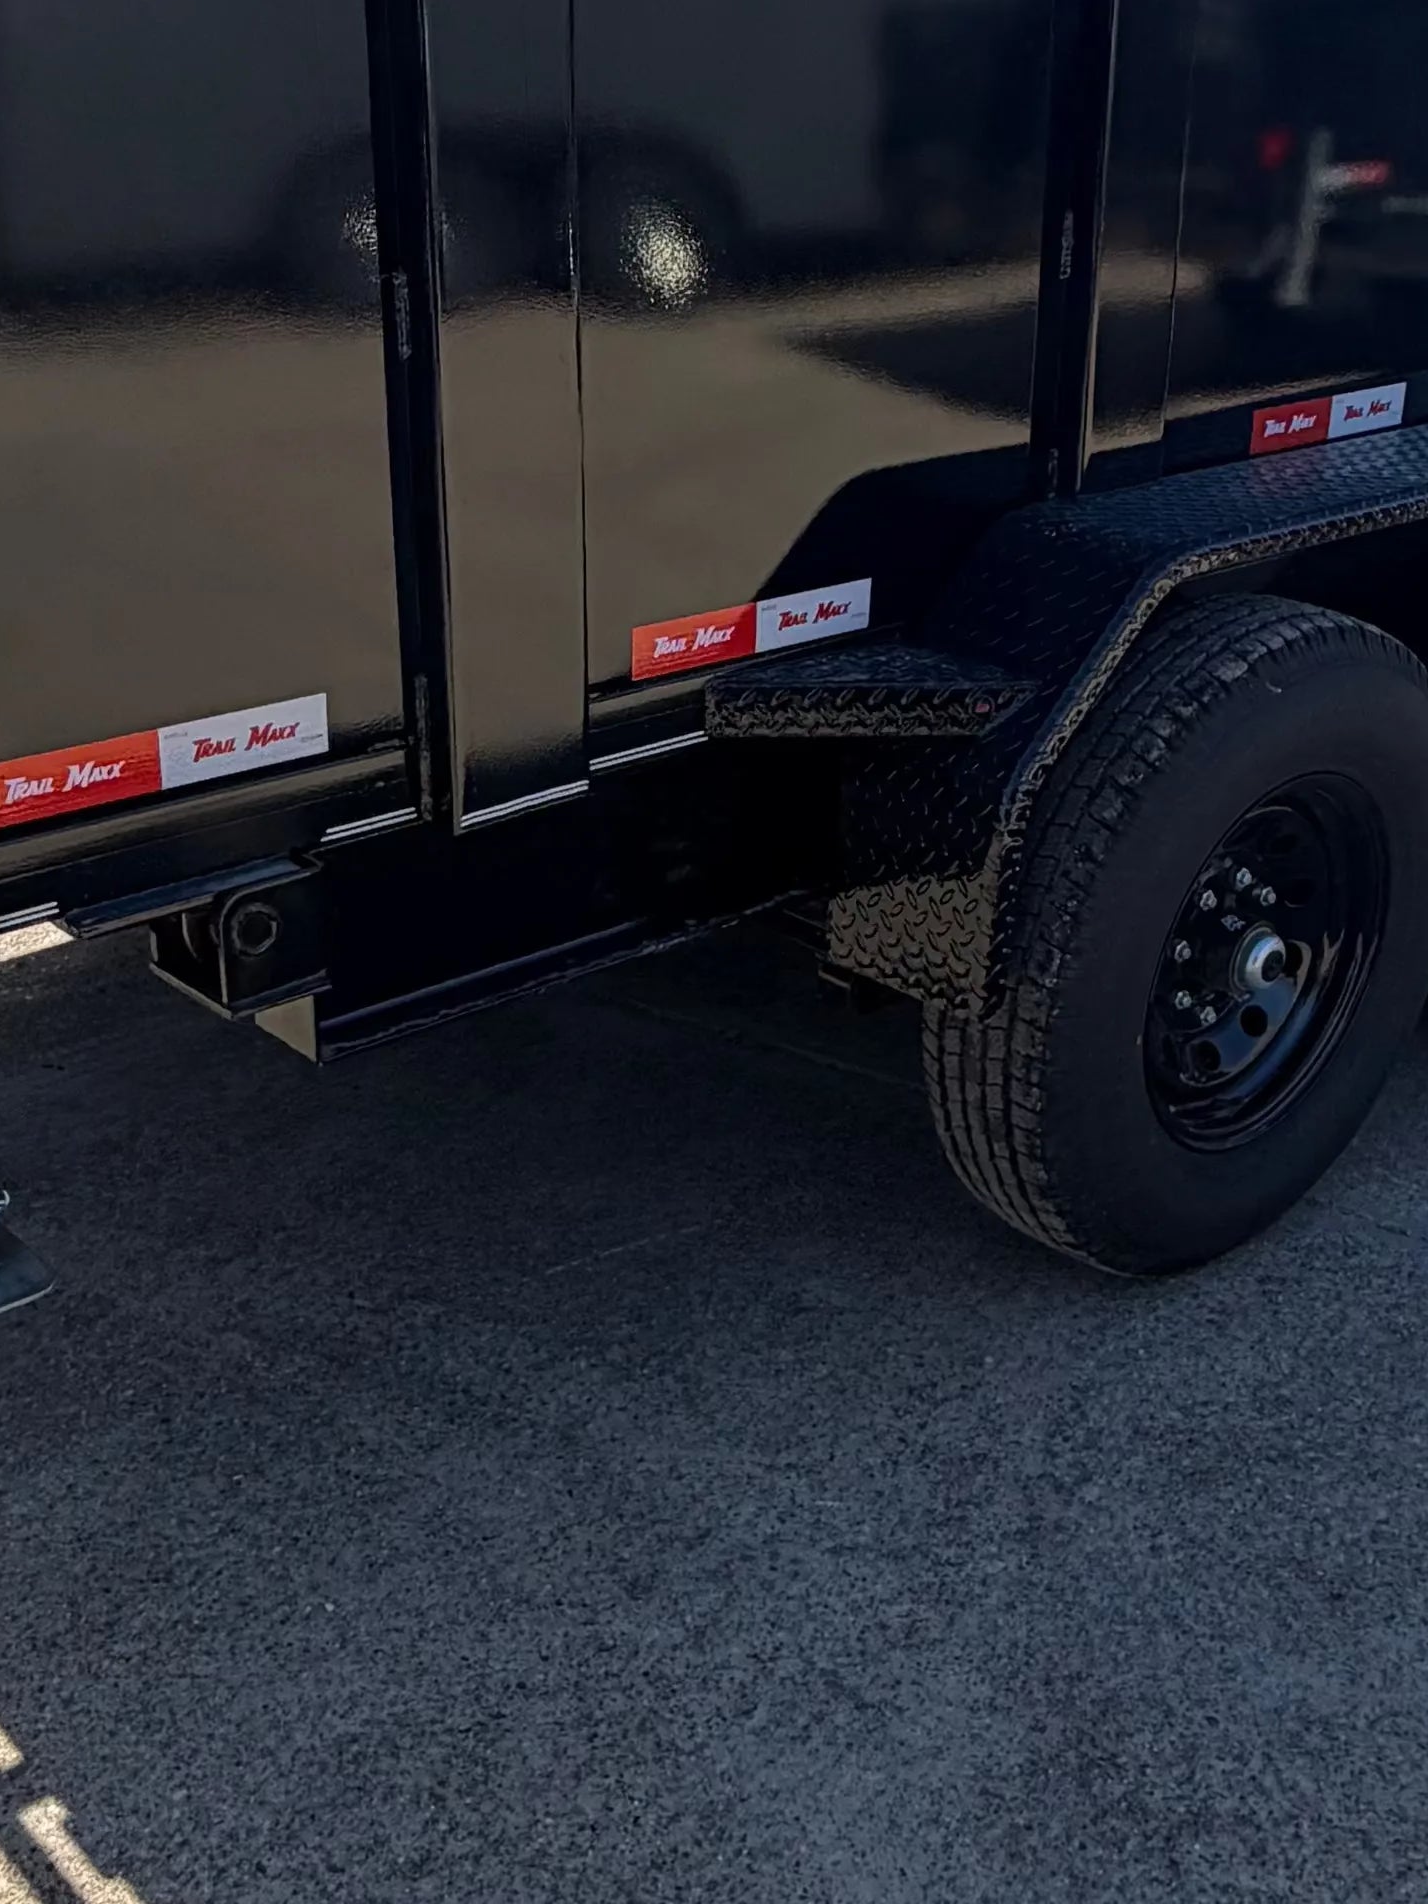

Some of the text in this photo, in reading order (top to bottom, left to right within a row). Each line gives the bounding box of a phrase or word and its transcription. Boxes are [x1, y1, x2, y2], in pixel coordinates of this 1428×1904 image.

[192, 721, 300, 763] TRAIL MAXX
[4, 760, 126, 805] TRAIL MAXX
